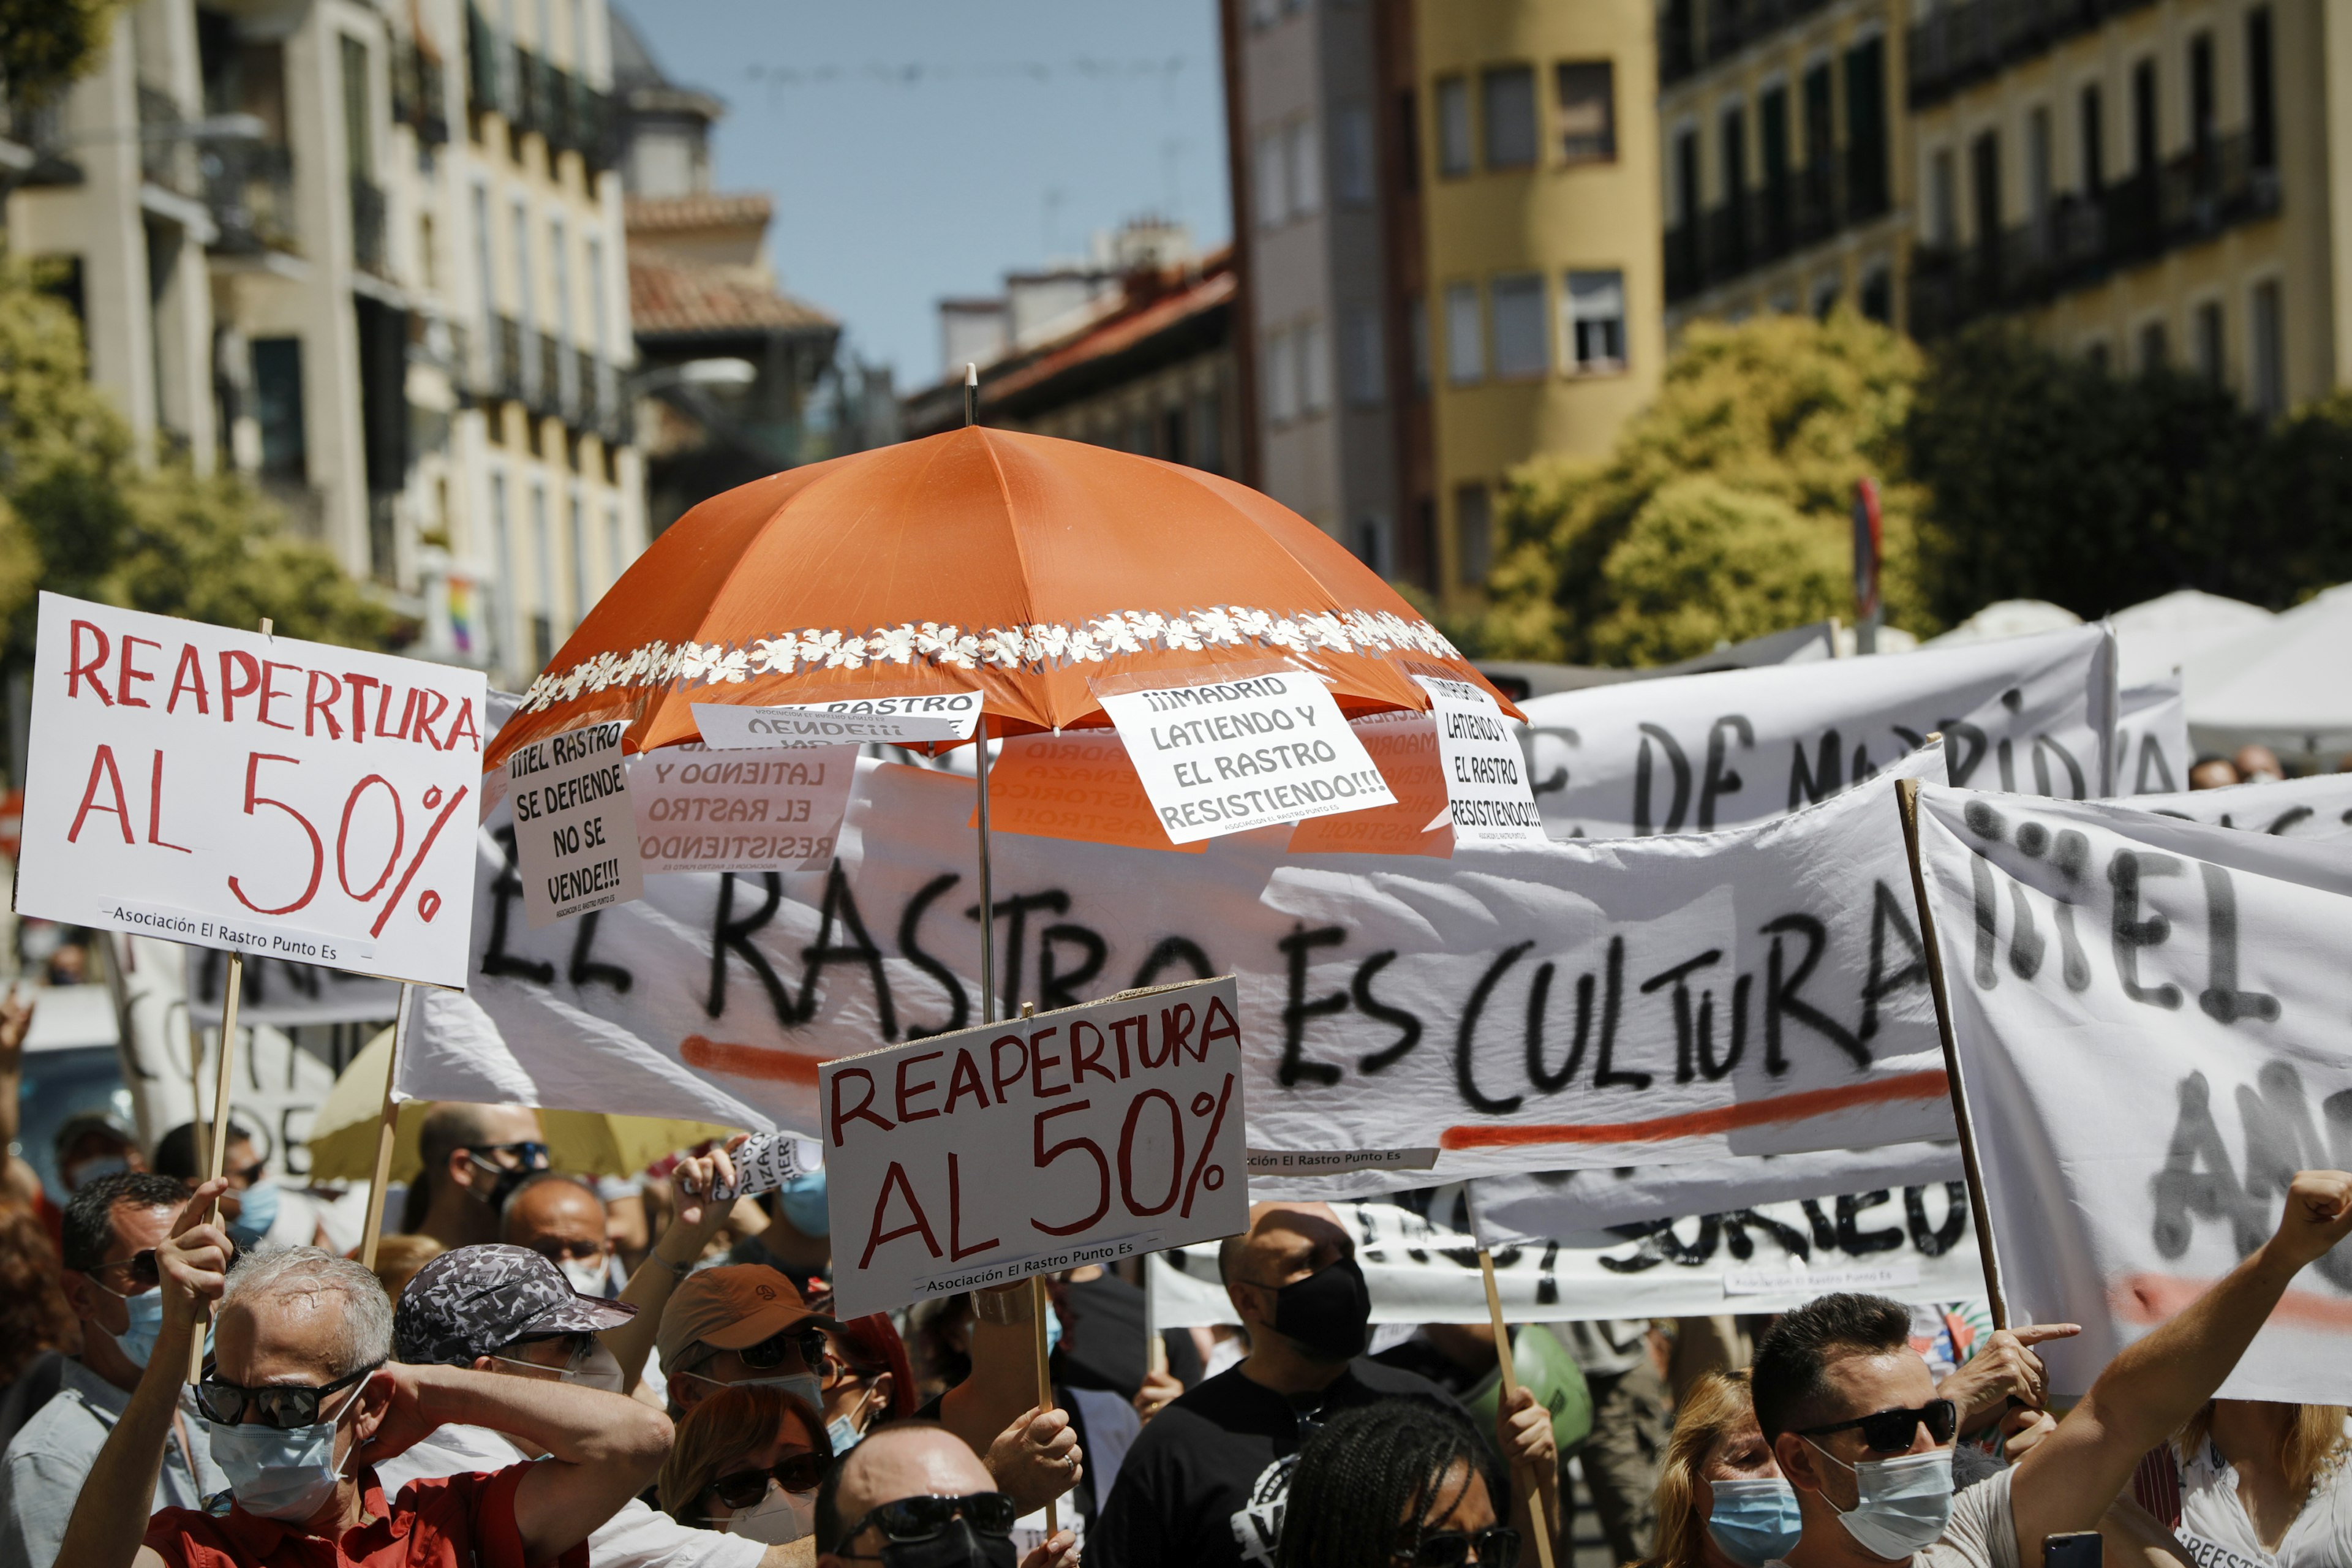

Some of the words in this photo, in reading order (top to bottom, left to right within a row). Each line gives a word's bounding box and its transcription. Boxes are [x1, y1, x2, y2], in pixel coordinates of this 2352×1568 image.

[64, 619, 481, 752] REAPERTURA
[1142, 676, 1287, 712] ¡¡¡MADRID
[511, 743, 549, 778] ¡¡¡EL
[552, 722, 621, 765] RASTRO
[1150, 708, 1294, 750] LATIENDO
[1295, 705, 1316, 727] Y
[1446, 712, 1499, 741] LATIENDO
[1496, 719, 1508, 742] Y
[1173, 761, 1212, 788] EL
[1215, 739, 1336, 780] RASTRO
[1455, 756, 1471, 783] EL
[1471, 756, 1518, 785] RASTRO
[517, 790, 541, 822] SE
[545, 764, 625, 814] DEFIENDE
[1160, 769, 1386, 830] RESISTIENDO!!!
[1450, 799, 1541, 827] RESISTIENDO!!!
[67, 744, 192, 853] AL
[227, 752, 469, 939] 50%
[553, 826, 579, 858] NO
[584, 816, 606, 848] SE
[1225, 818, 1267, 831] ASOCIACION
[1277, 810, 1305, 821] RASTRO
[1306, 805, 1329, 815] PUNTO
[548, 858, 620, 905] VENDE!!!
[114, 907, 195, 934] Asociación
[201, 923, 213, 938] El
[219, 926, 267, 948] Rastro
[273, 936, 316, 956] Punto
[322, 945, 337, 960] Es
[1276, 922, 1422, 1089] ES
[1455, 879, 1940, 1115] CULTURA
[831, 995, 1242, 1148] REAPERTURA
[858, 1152, 1000, 1269] AL
[1030, 1073, 1235, 1236] 50%
[1283, 1155, 1293, 1166] El
[1298, 1155, 1340, 1166] Rastro
[1345, 1152, 1382, 1163] Punto
[1387, 1151, 1401, 1161] Es
[927, 1268, 1002, 1292] Asociación
[1008, 1265, 1019, 1276] El
[1024, 1255, 1068, 1272] Rastro
[1073, 1247, 1114, 1262] Punto
[1119, 1243, 1133, 1254] Es
